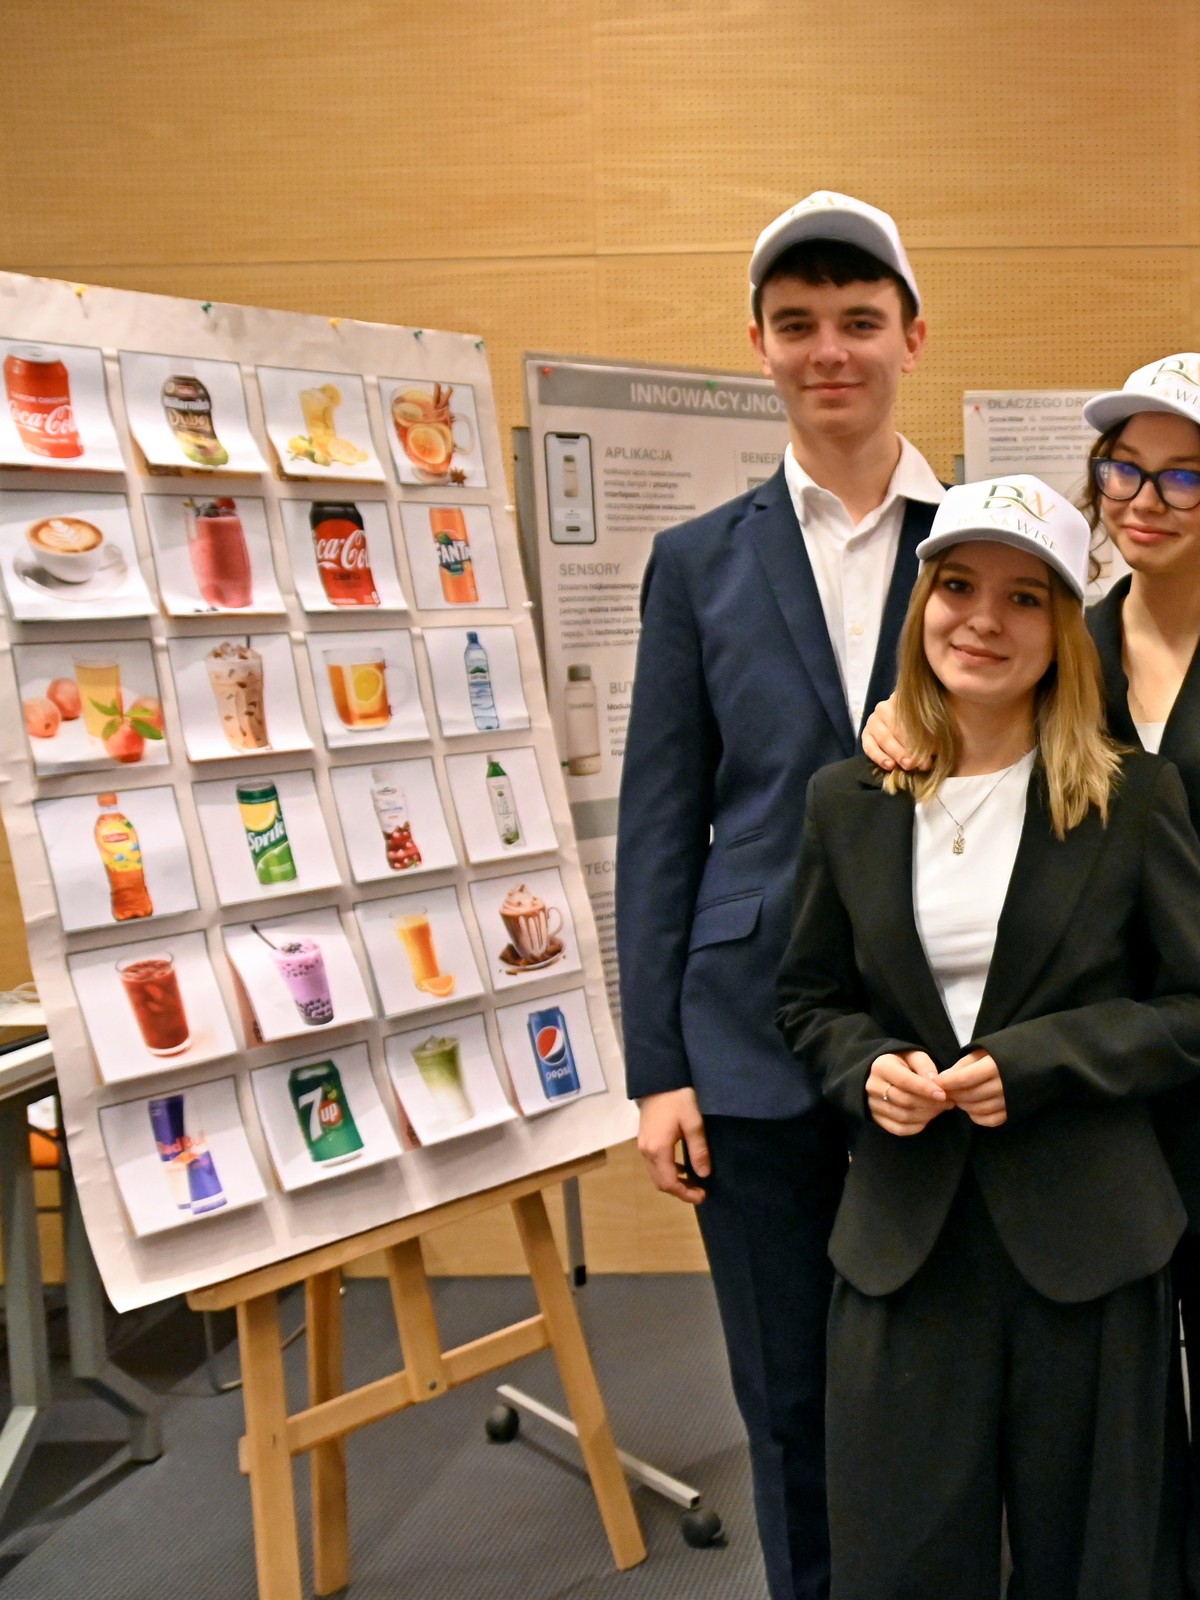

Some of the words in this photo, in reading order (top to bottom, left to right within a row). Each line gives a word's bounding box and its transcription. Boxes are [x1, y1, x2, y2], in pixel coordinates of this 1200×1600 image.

[988, 398, 1062, 410] DLACZEGO
[9, 400, 78, 435] Coca-Col
[605, 447, 673, 461] APLIKACJA
[559, 563, 621, 576] SENSORY
